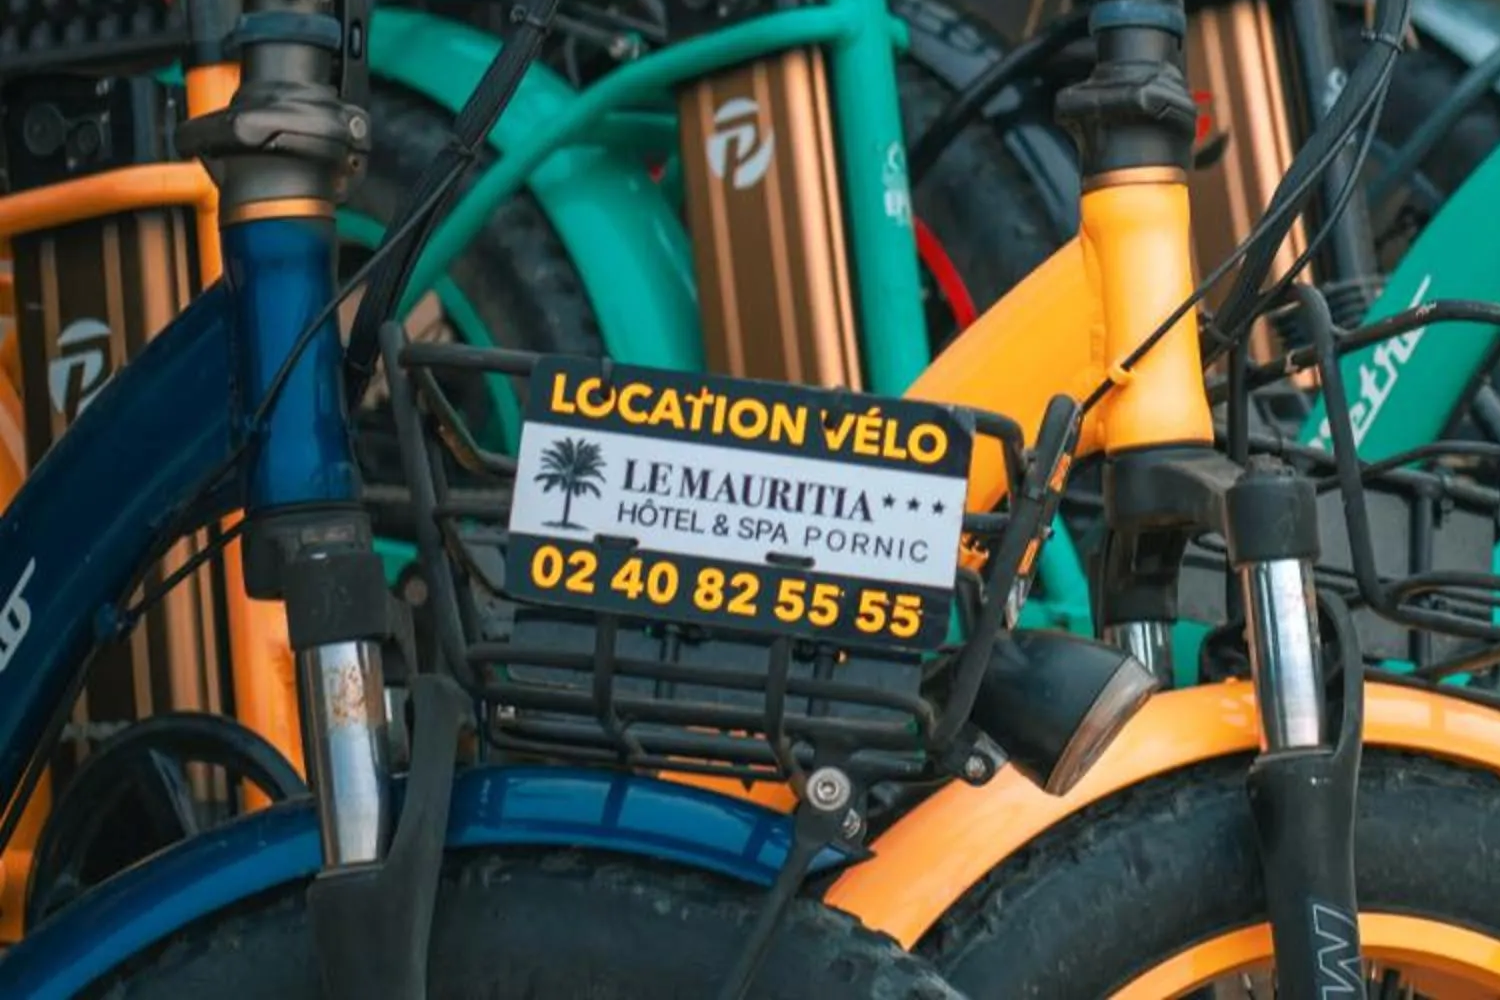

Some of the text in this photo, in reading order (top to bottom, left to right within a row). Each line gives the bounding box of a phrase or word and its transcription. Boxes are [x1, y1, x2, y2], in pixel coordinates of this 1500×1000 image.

[550, 372, 947, 464] LOCATION VÉLO
[622, 458, 874, 522] LE MAURITIA
[617, 499, 929, 564] HÔTEL & SPA PORNIC
[530, 544, 922, 639] 02 40 82 55 55
